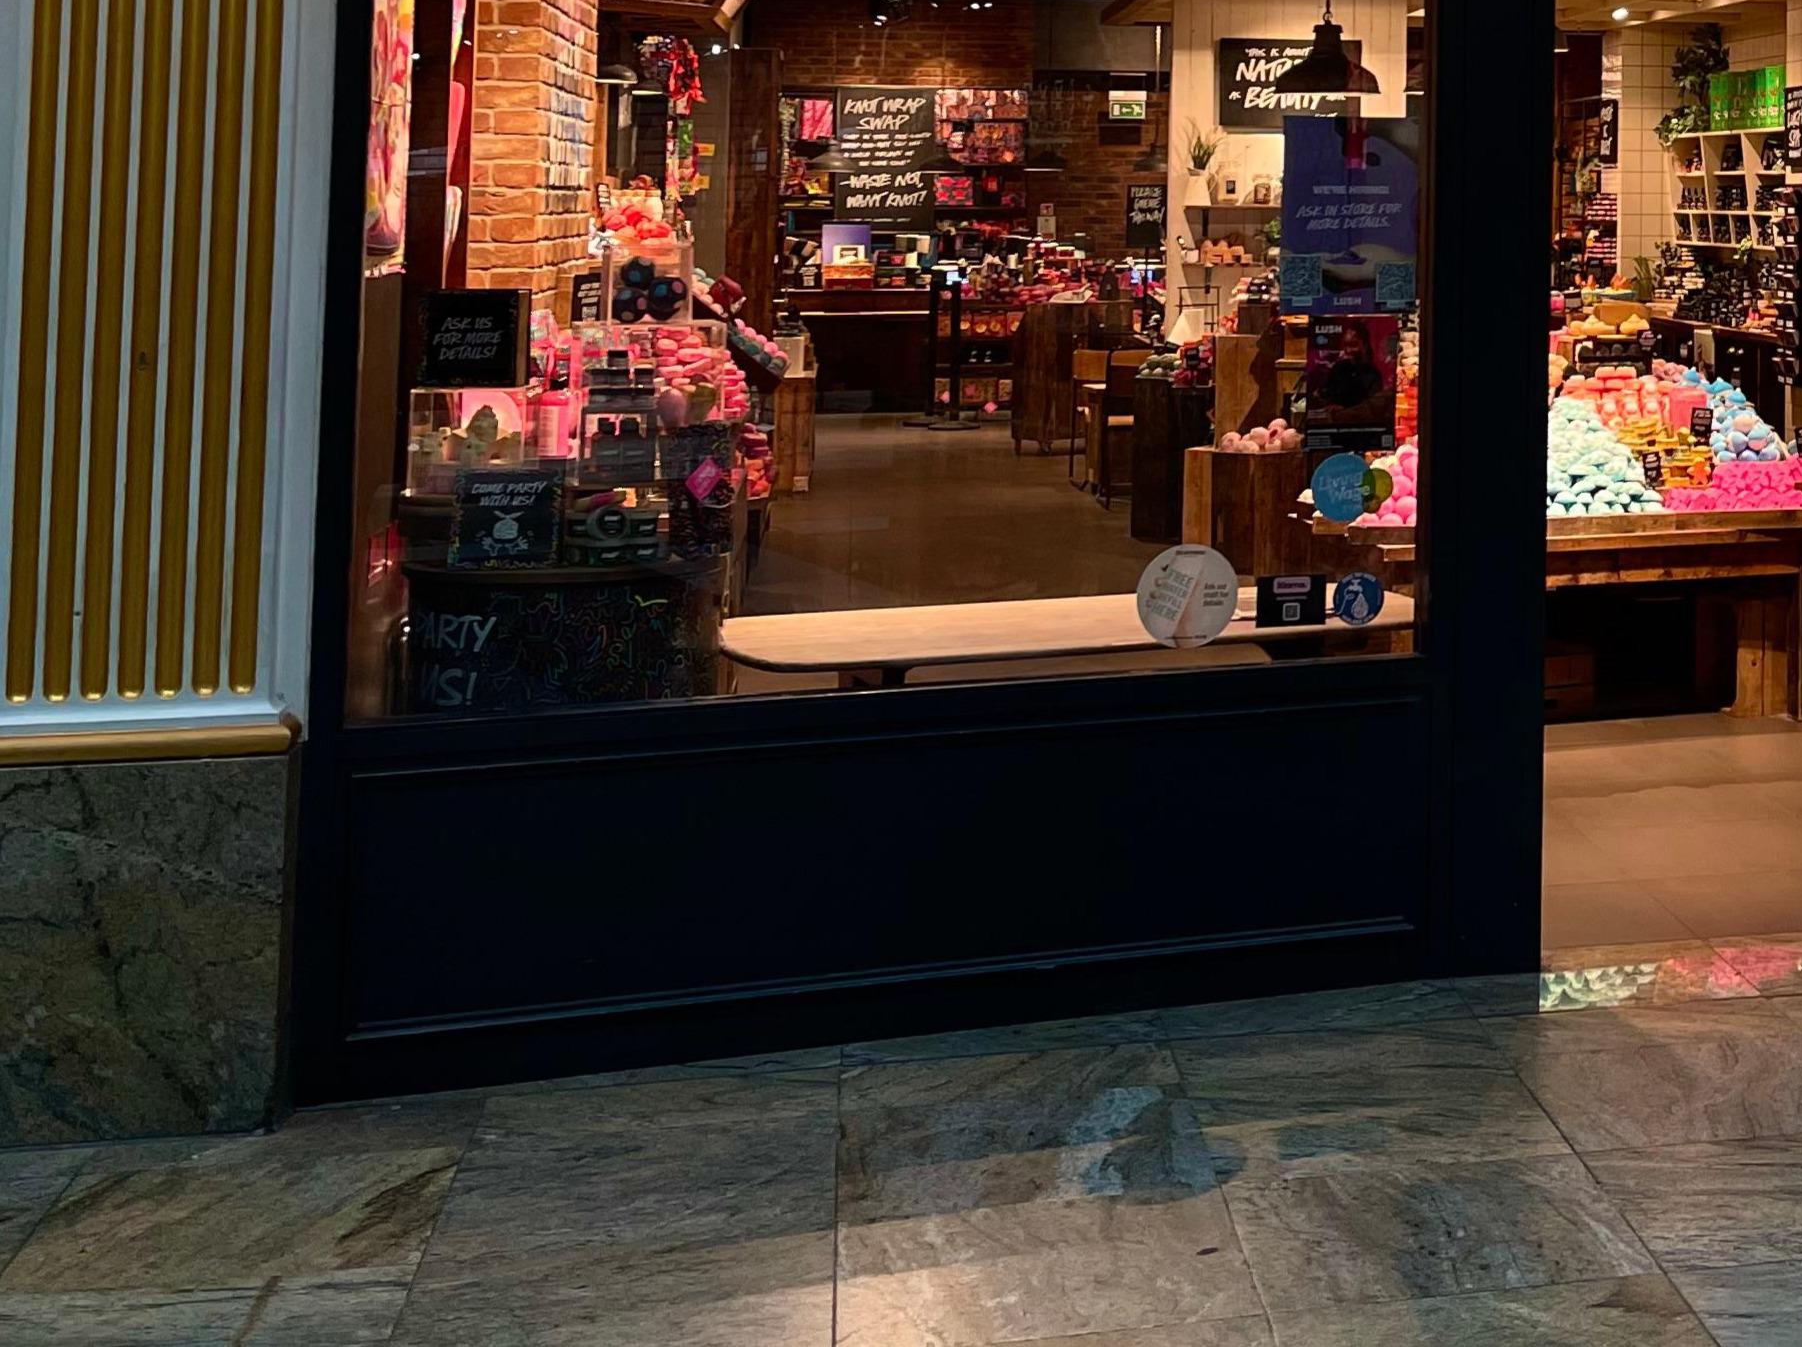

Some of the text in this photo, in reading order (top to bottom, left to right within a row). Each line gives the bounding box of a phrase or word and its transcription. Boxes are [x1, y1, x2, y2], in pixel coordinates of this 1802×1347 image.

[843, 96, 926, 115] KNOT WRAP
[855, 114, 910, 131] SWAP
[845, 190, 928, 209] WANT KNOT!
[1296, 205, 1323, 218] ASK
[1324, 205, 1338, 216] IN
[1339, 203, 1376, 216] STORE
[1306, 218, 1341, 230] MORE
[440, 316, 472, 332] ASK
[1314, 325, 1344, 334] LUSH
[432, 330, 505, 346] FOR MORE
[438, 346, 497, 361] DETAILS!
[472, 481, 548, 494] COME PARTY
